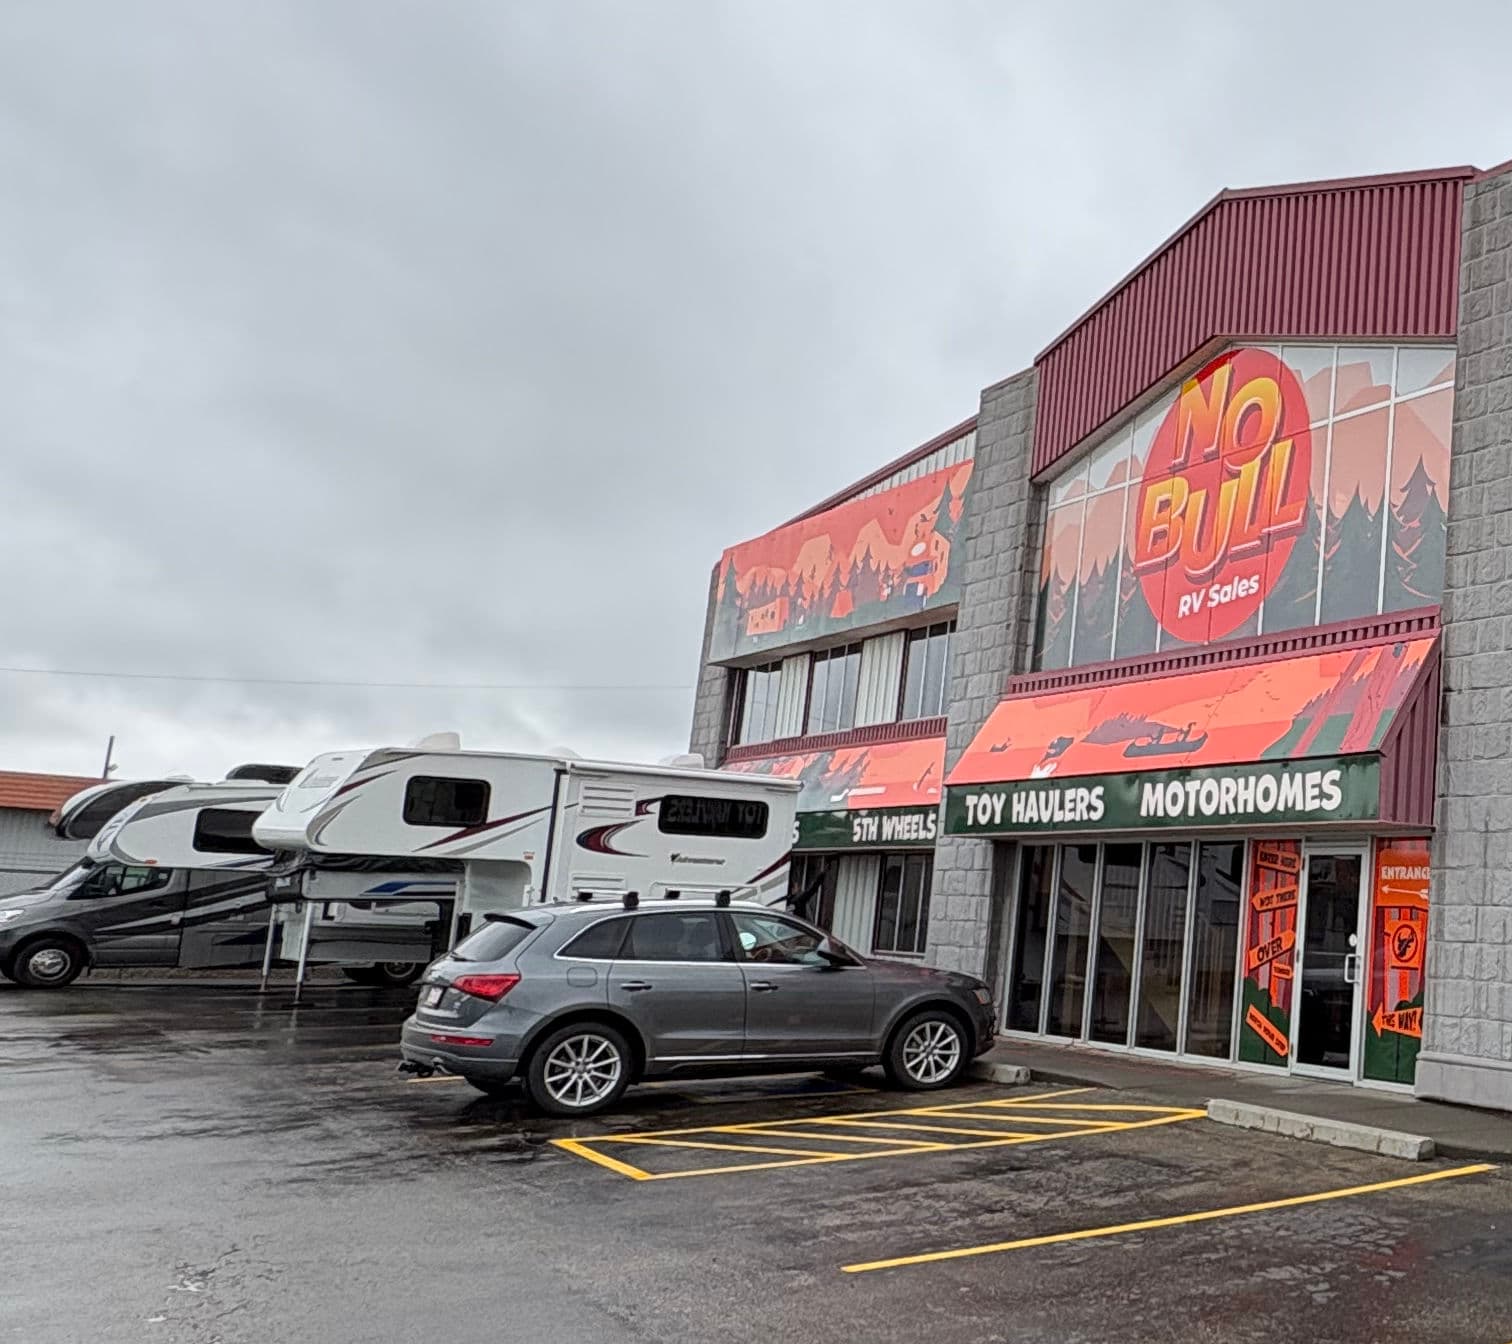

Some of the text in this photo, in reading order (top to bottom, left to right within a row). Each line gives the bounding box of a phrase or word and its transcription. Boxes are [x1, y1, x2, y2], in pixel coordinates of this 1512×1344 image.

[1172, 361, 1282, 471] NO
[1135, 439, 1306, 578] BULL
[1177, 574, 1260, 618] RV Sales
[965, 785, 1105, 827] TOY HAULERS
[1139, 769, 1343, 818] MOTORHOMES
[852, 812, 938, 843] 5TH WHEELS
[1256, 936, 1283, 962] OVER
[1397, 1009, 1417, 1032] WAY!
